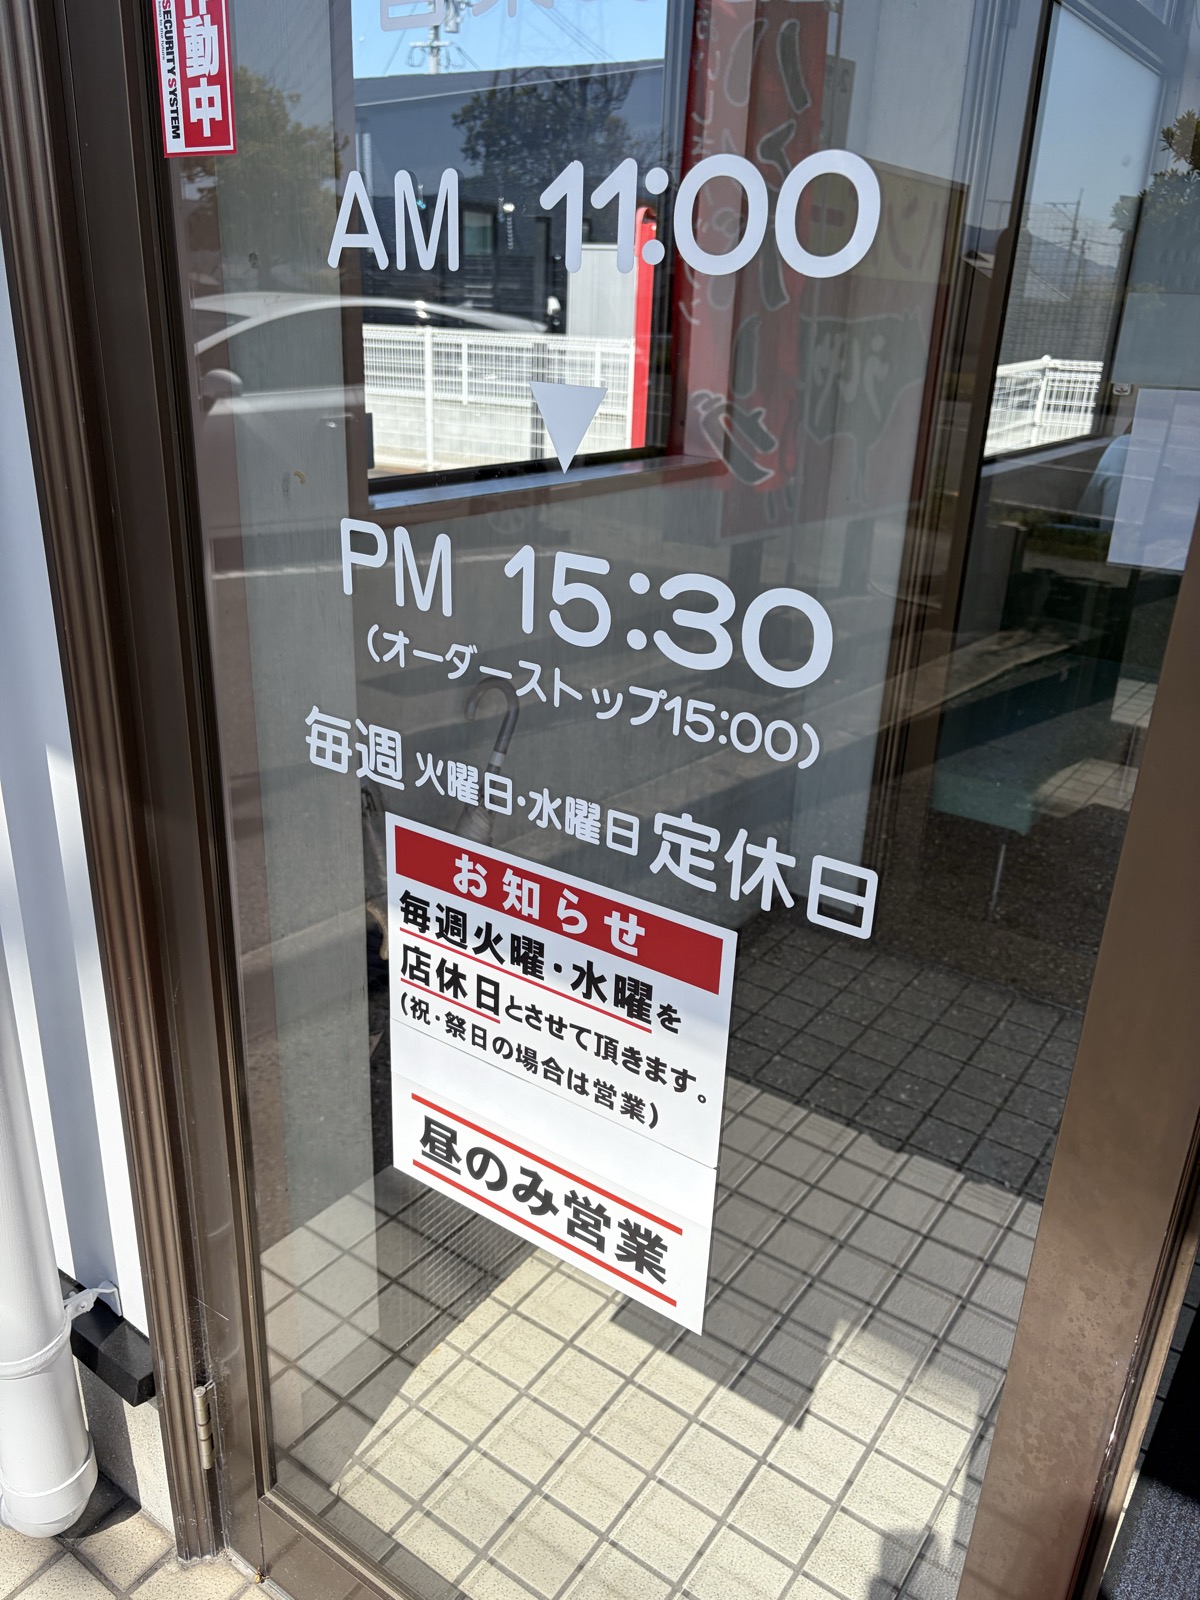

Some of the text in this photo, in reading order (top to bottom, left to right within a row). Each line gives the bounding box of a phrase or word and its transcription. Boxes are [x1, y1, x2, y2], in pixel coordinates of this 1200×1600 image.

[167, 78, 181, 140] SYSTEM
[182, 0, 223, 137] 動中
[327, 167, 461, 272] AM
[538, 149, 881, 278] 11:00
[340, 517, 834, 689] PM 15:30
[367, 624, 820, 770] (オーダーストップ15:00)
[399, 890, 681, 1035] 毎週火曜・水曜を
[452, 853, 646, 956] お知らせ
[400, 944, 708, 1105] 店休日とさせて頂きます。
[400, 991, 659, 1129] (祝・祭日の場合は営業)
[419, 1114, 669, 1284] 昼のみ営業
